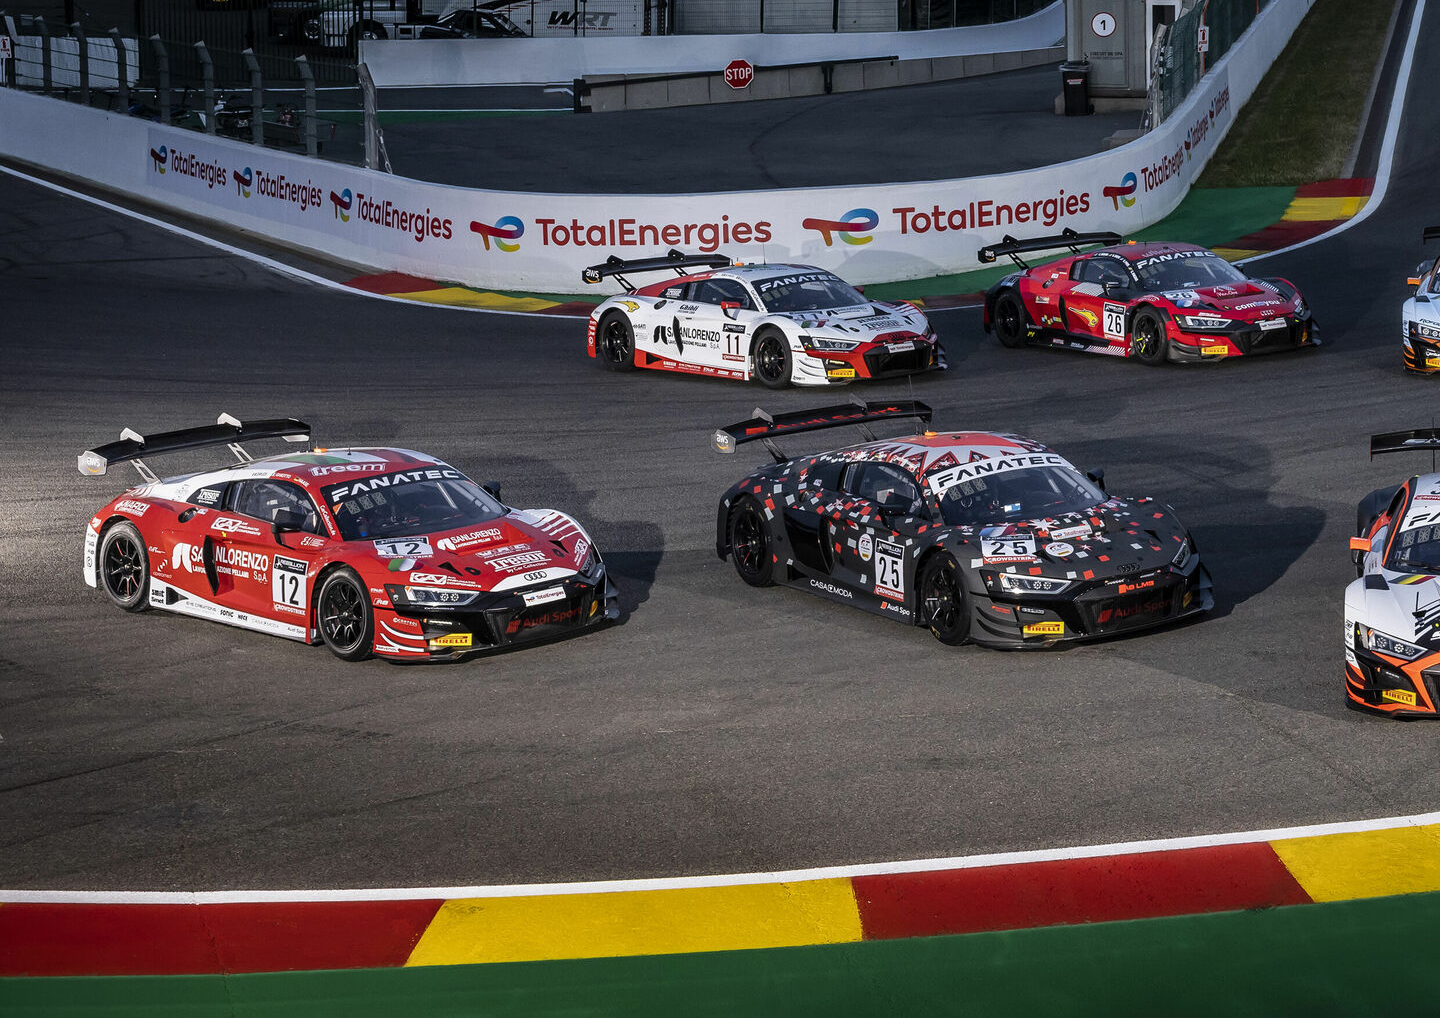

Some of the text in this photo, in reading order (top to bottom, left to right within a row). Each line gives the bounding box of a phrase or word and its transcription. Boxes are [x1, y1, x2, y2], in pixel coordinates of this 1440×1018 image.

[548, 11, 617, 27] WRT
[1100, 19, 1106, 31] 1
[726, 67, 752, 80] STOP
[170, 148, 227, 189] TotalEnergies
[255, 170, 322, 212] TotalEnergies
[356, 193, 452, 242] TotalEnergies
[892, 189, 1091, 236] TotalEnergies
[535, 215, 772, 253] TotalEnergies
[1136, 251, 1216, 269] FANATEC
[586, 269, 599, 279] aws
[760, 274, 838, 292] FANATEC
[1107, 313, 1122, 334] 26
[726, 333, 740, 355] 11
[829, 369, 853, 377] PIRELLI
[717, 433, 729, 444] aws
[938, 453, 1062, 488] FANATEC
[333, 469, 461, 502] FANATEC
[450, 528, 501, 545] SANLORENZO
[1063, 528, 1091, 538] TotalEnergies
[387, 541, 423, 556] 12
[991, 541, 1028, 555] 25
[191, 544, 269, 572] SANLORENZO
[282, 559, 305, 570] REBELLION
[523, 561, 548, 570] Collection
[232, 569, 249, 578] PELLAMI
[880, 556, 900, 589] 25
[280, 573, 299, 606] 12
[1135, 581, 1154, 590] LMS
[535, 588, 565, 601] TotalEnergies
[887, 603, 898, 614] Audi
[1114, 605, 1138, 619] Audi
[521, 607, 582, 628] Audi Sport
[1024, 623, 1062, 633] PIRELLI
[434, 635, 469, 645] PIRELLI
[1384, 689, 1415, 704] PIRELLI
